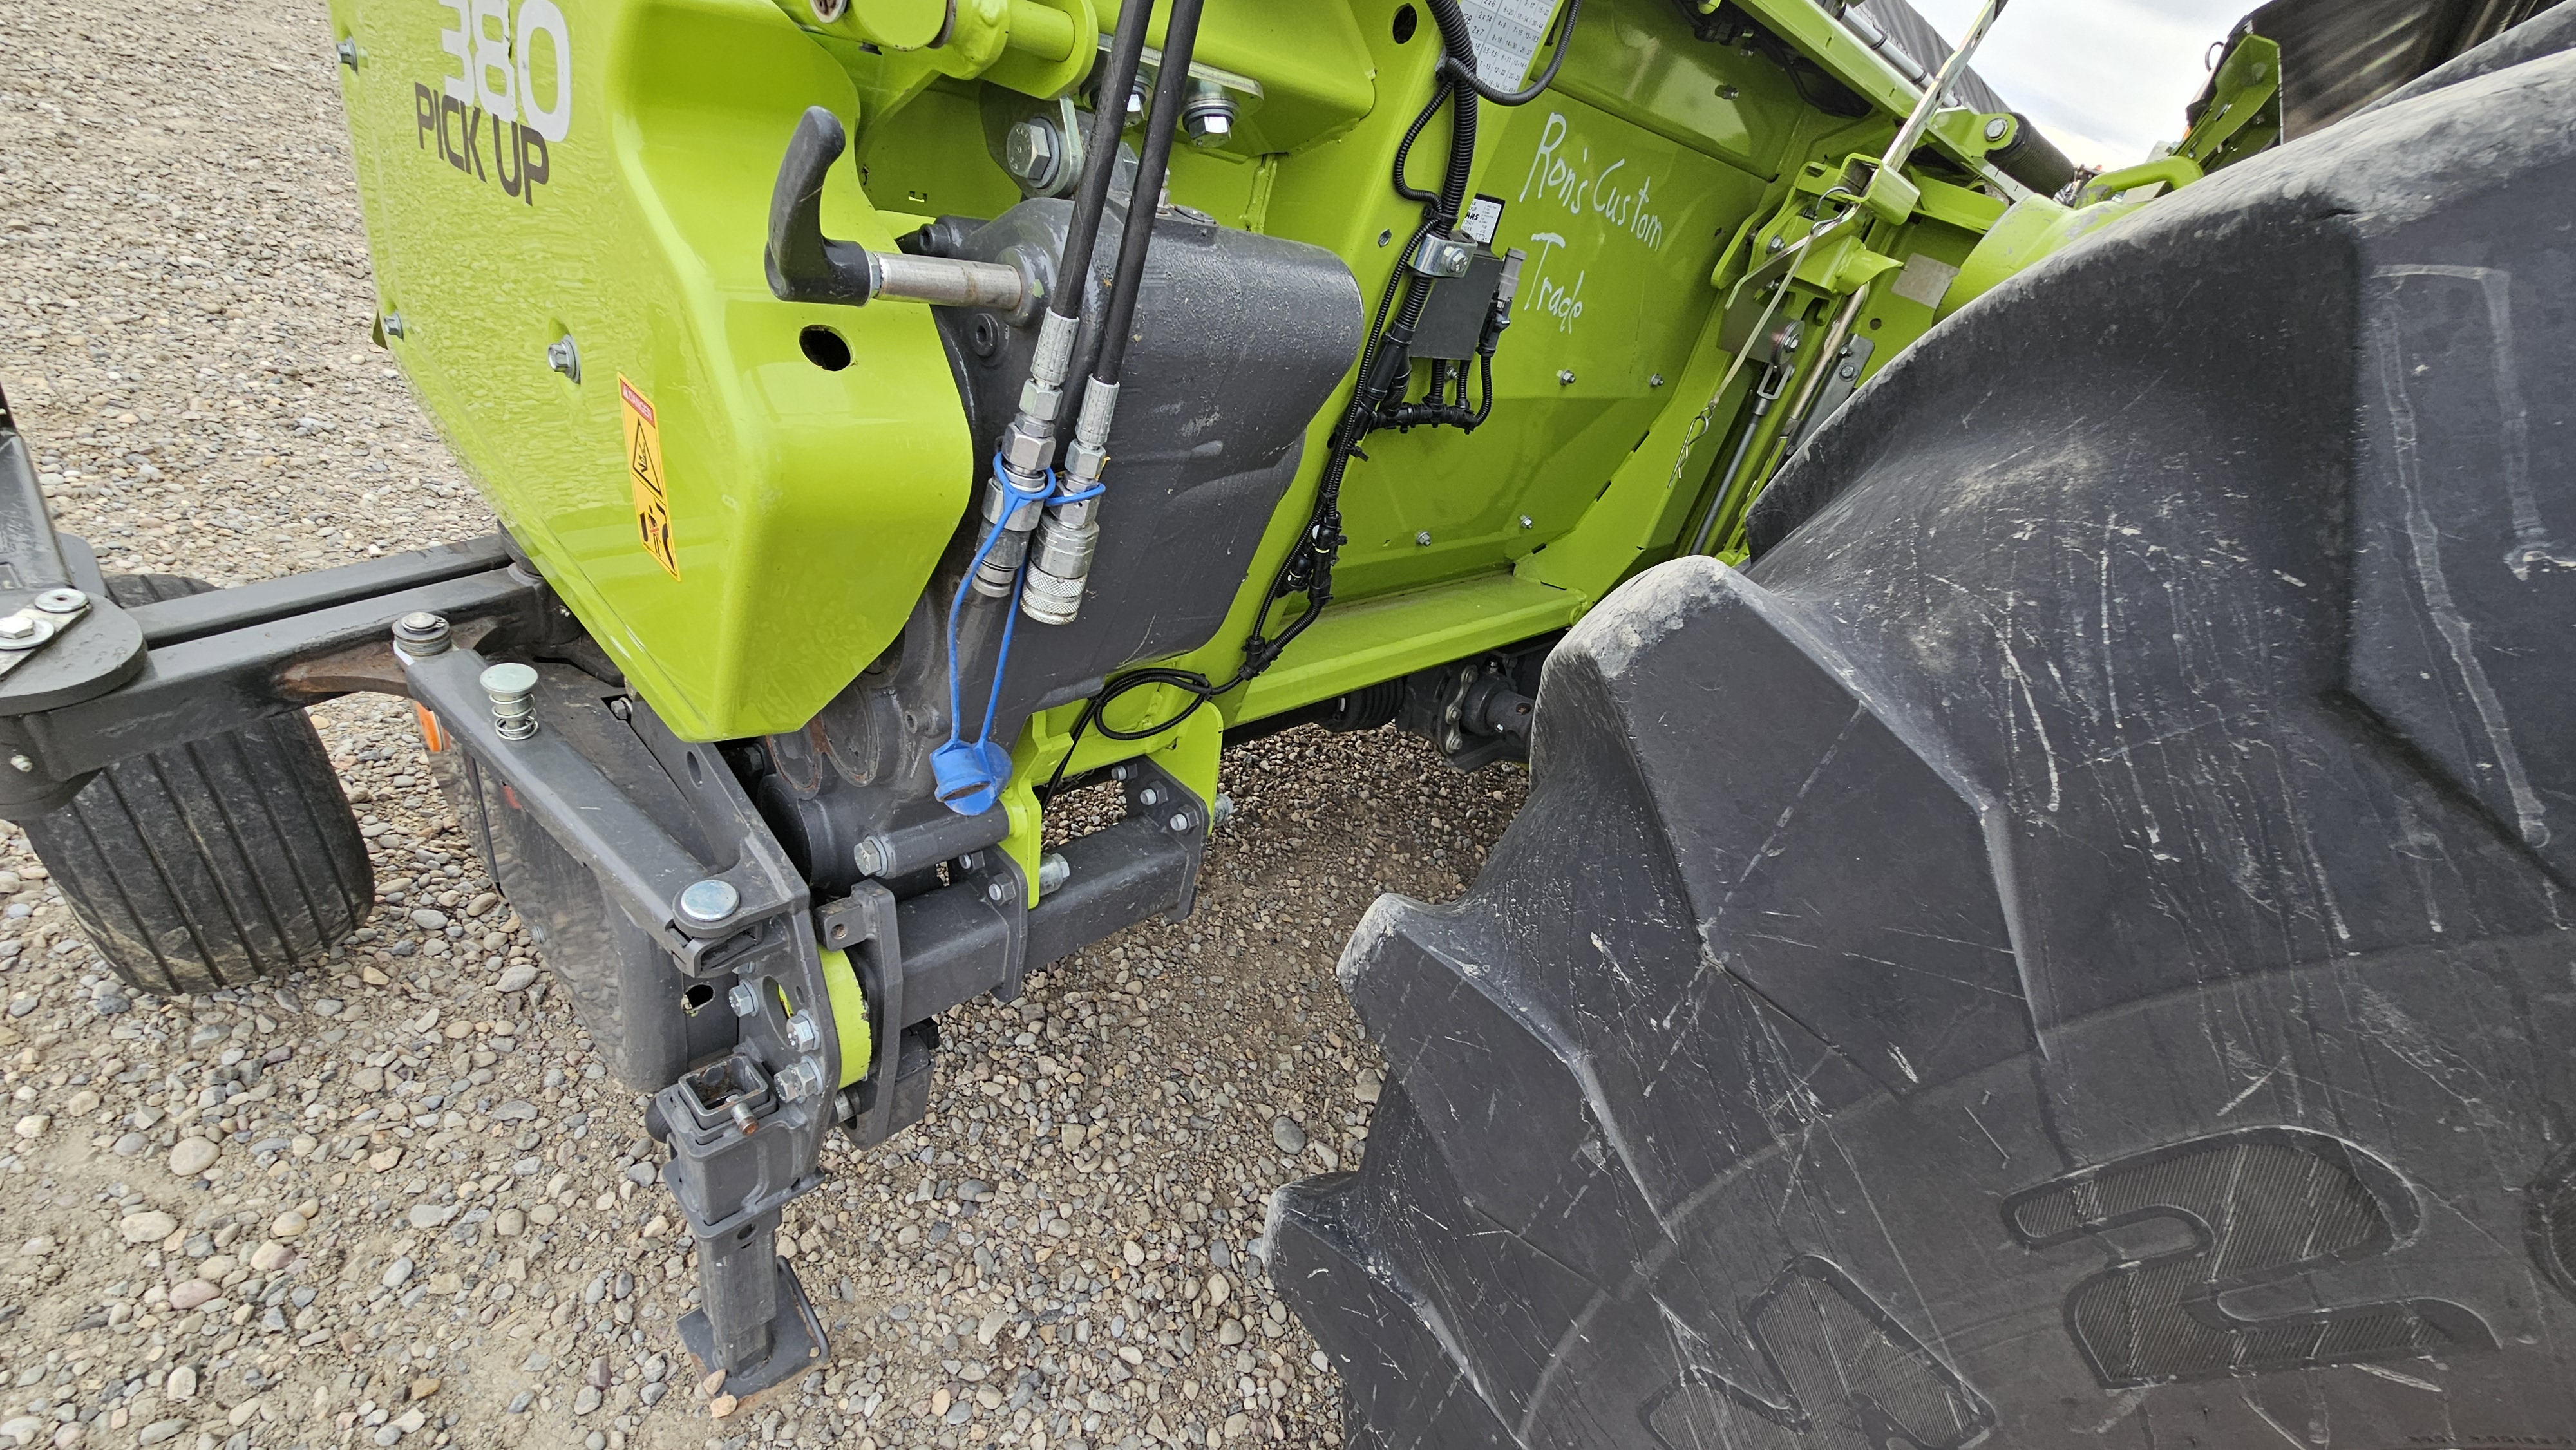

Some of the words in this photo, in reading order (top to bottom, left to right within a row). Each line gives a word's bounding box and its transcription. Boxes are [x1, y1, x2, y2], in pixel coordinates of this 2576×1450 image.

[439, 0, 571, 142] 380
[415, 82, 487, 184] PICK
[492, 113, 549, 207] UP
[1519, 112, 1589, 214] Ron's
[1593, 158, 1662, 252] Custom
